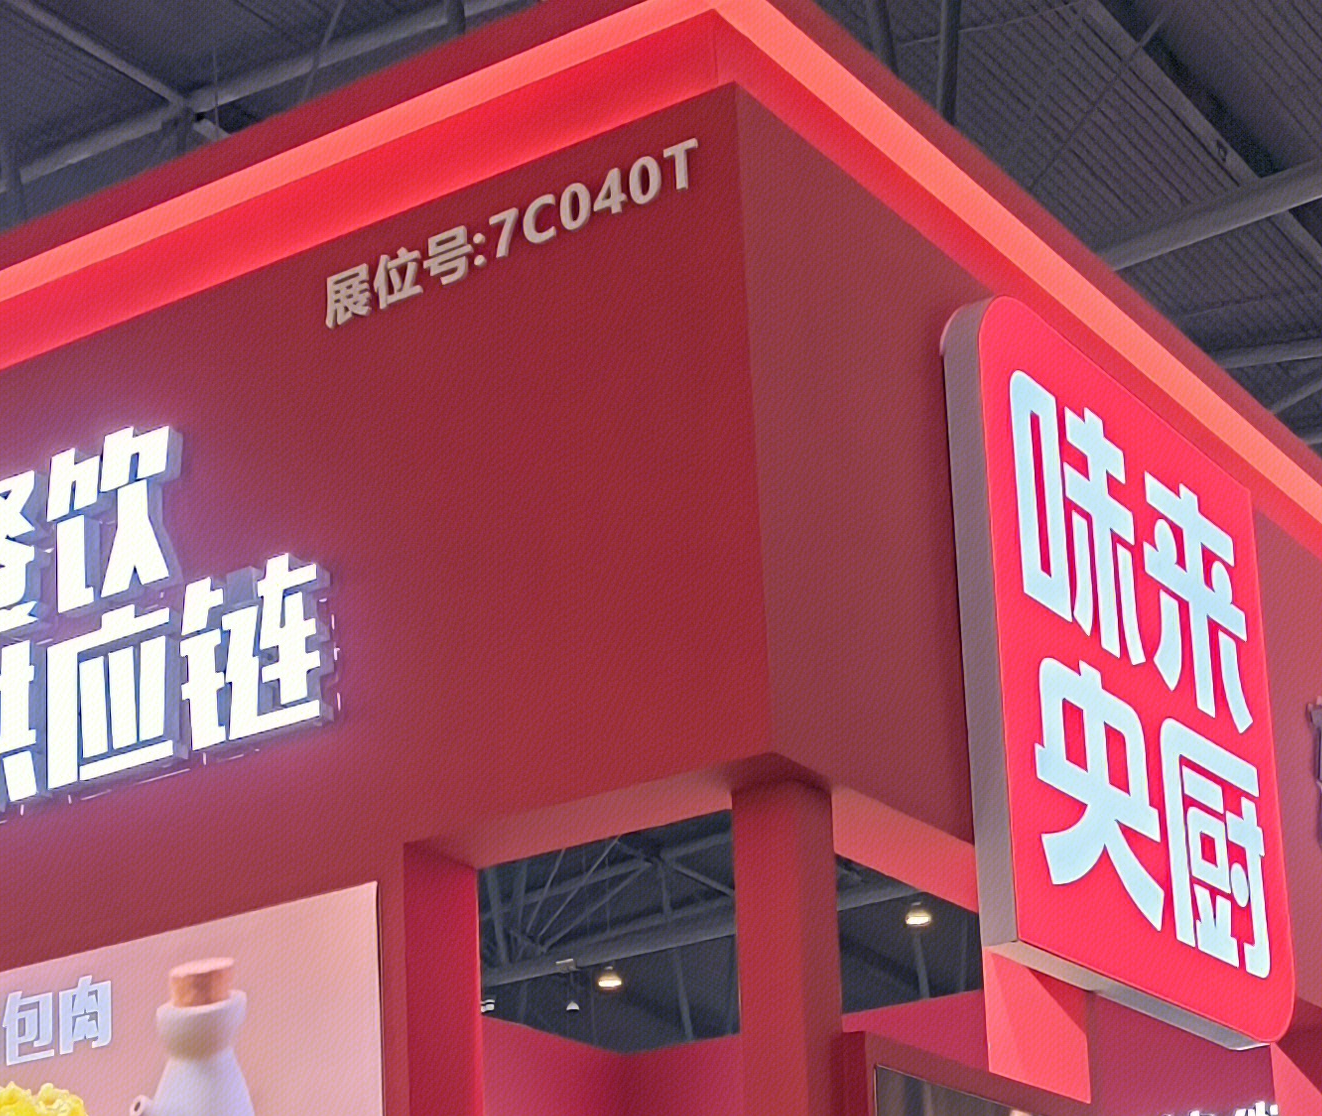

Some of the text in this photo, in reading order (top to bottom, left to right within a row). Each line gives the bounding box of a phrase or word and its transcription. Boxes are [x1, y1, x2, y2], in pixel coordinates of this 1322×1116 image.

[325, 138, 699, 329] 展位号:7C040T
[1009, 369, 1254, 735] 味来
[1034, 656, 1272, 979] 央厨
